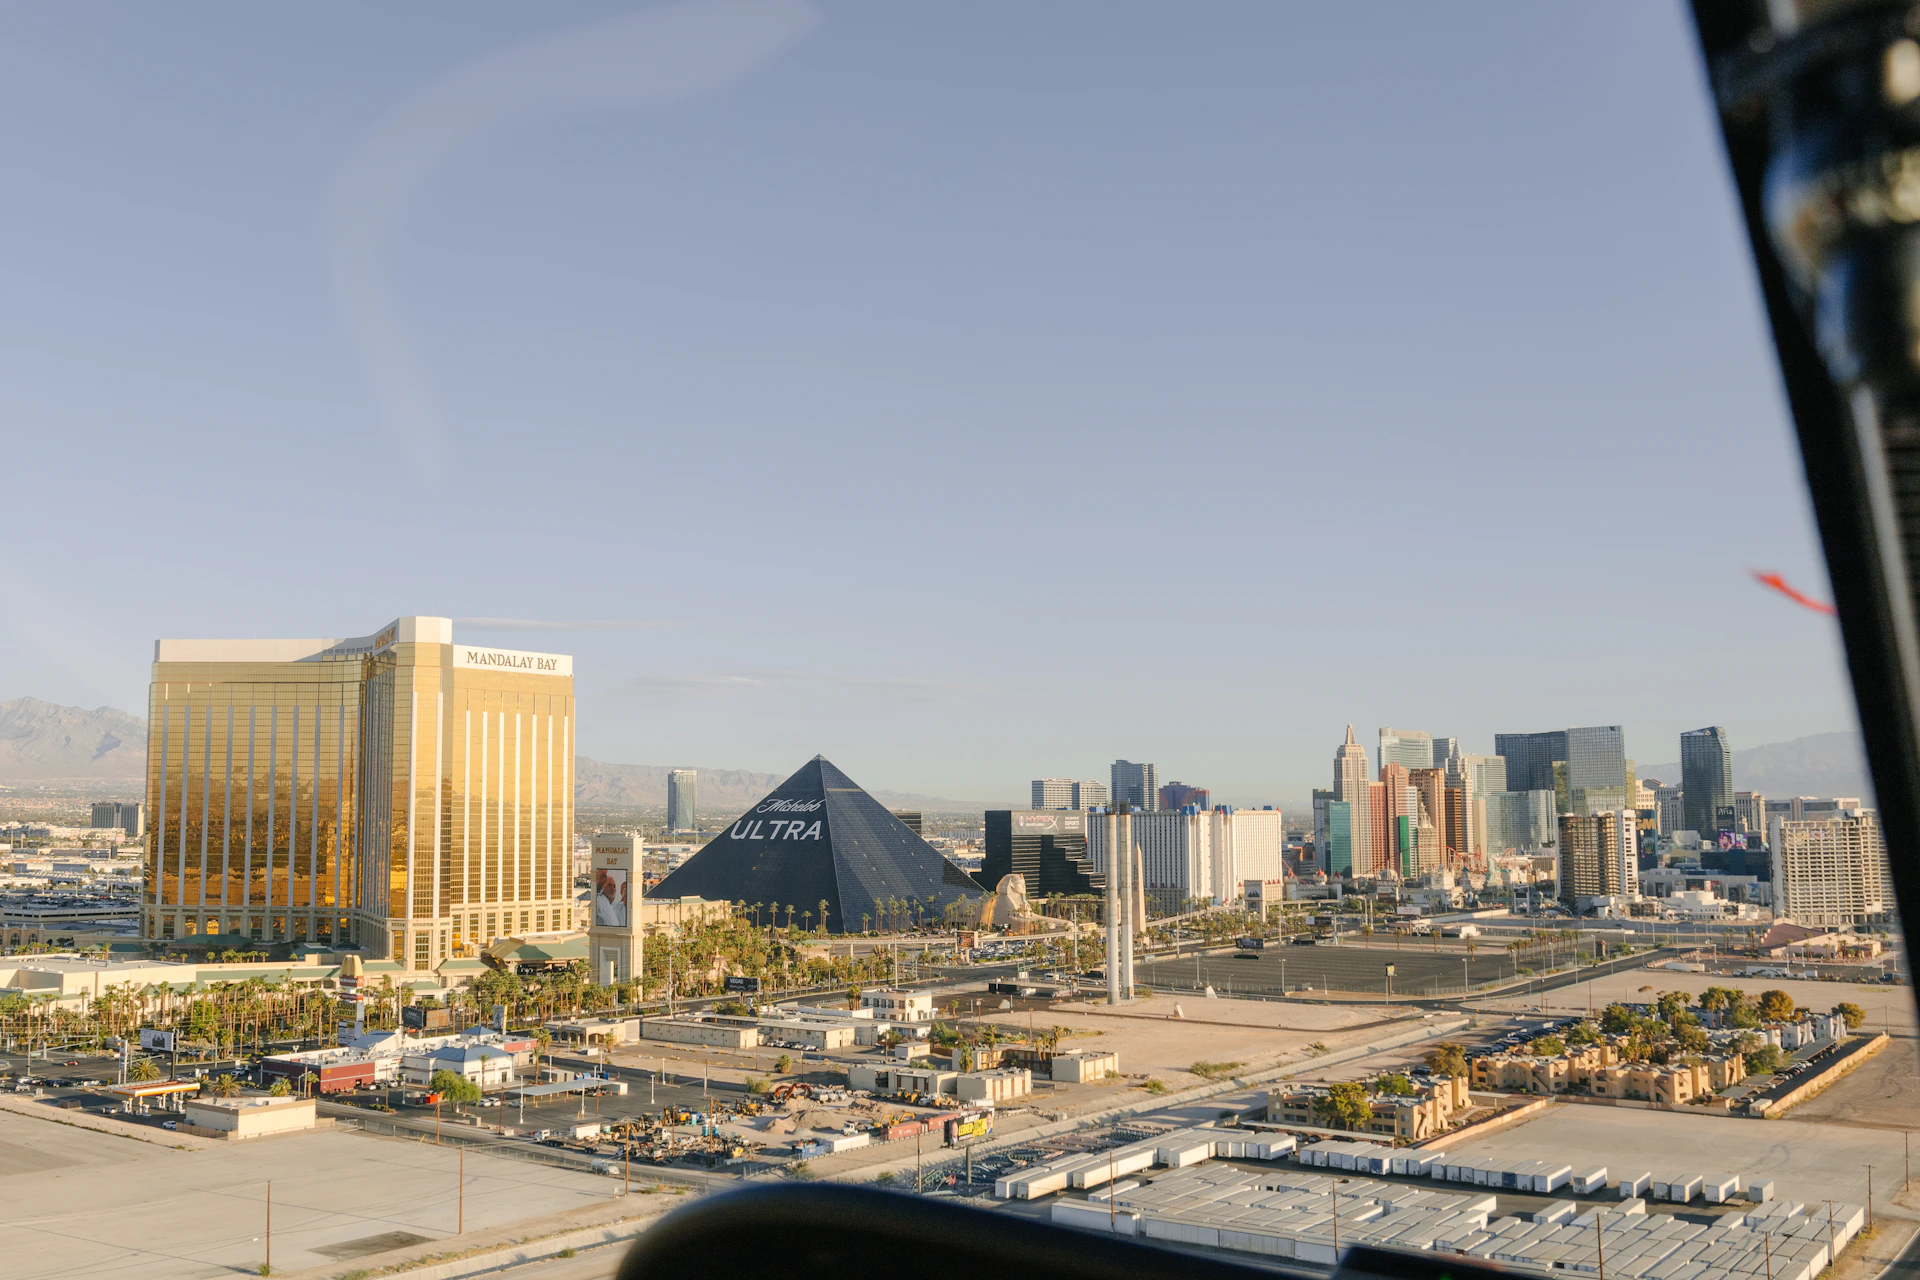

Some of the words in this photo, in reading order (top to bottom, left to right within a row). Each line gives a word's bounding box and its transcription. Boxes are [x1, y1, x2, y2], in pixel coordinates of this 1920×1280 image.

[466, 651, 534, 669] MANDALAY
[536, 657, 558, 671] BAY
[756, 798, 826, 814] Michelob
[730, 820, 822, 841] ULTRA
[595, 846, 630, 855] MANDALAY
[606, 857, 618, 865] BAY
